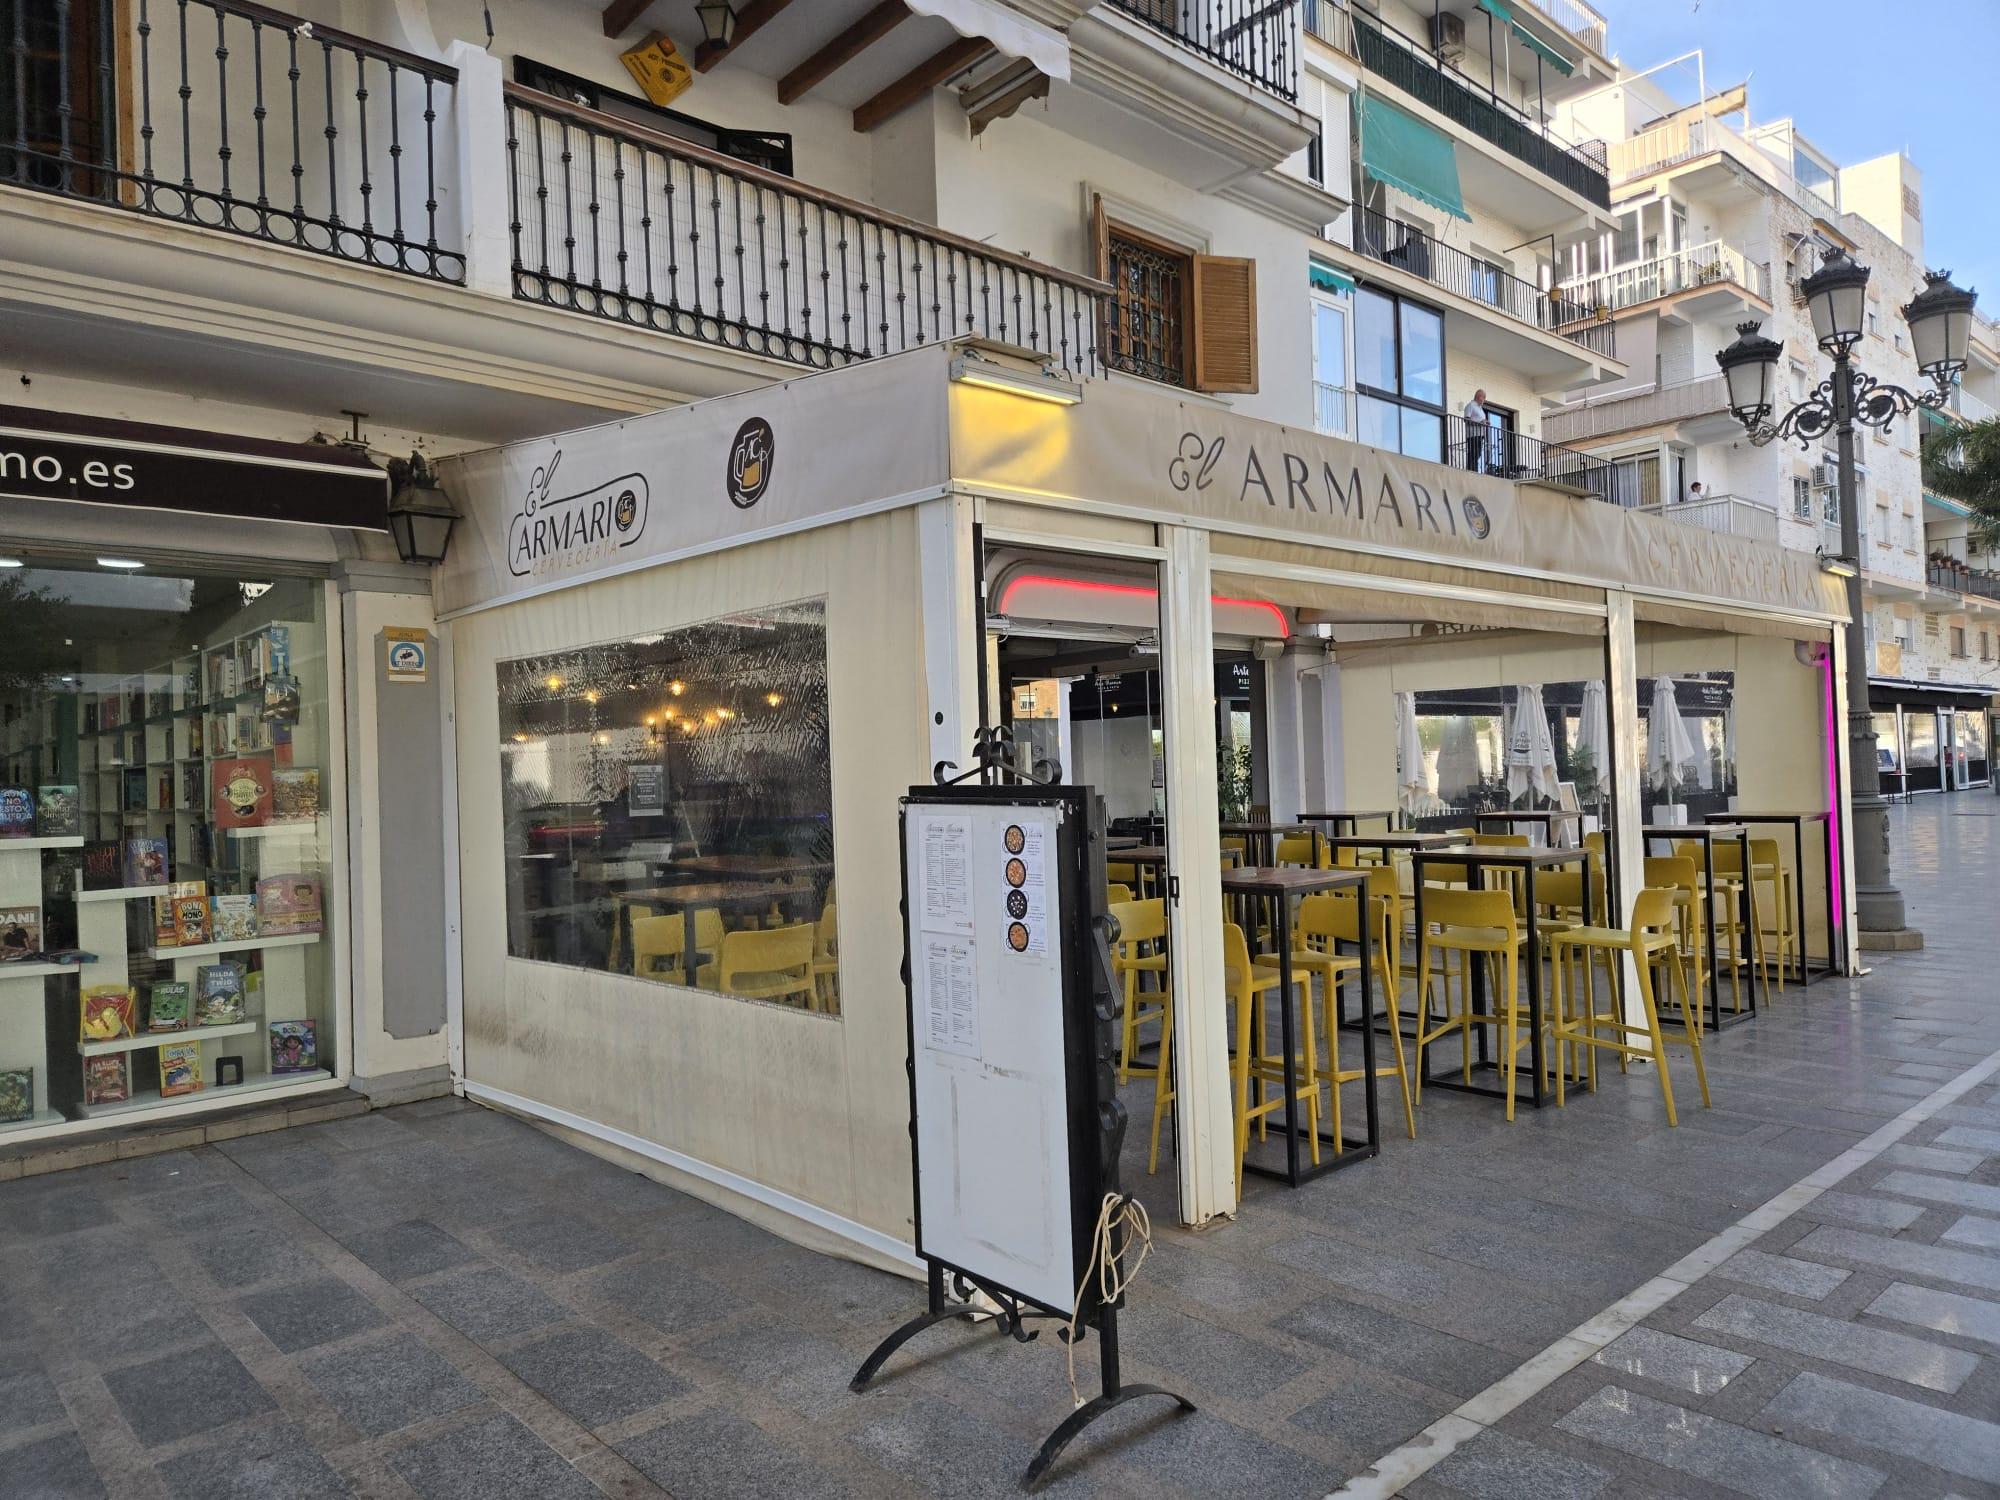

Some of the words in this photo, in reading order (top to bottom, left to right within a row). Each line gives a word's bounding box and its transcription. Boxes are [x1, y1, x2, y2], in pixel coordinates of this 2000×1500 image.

[524, 449, 562, 518] El
[1168, 431, 1226, 492] El
[1240, 444, 1491, 540] ARMARIO
[515, 488, 637, 564] ARMARIO
[182, 910, 203, 920] MONO
